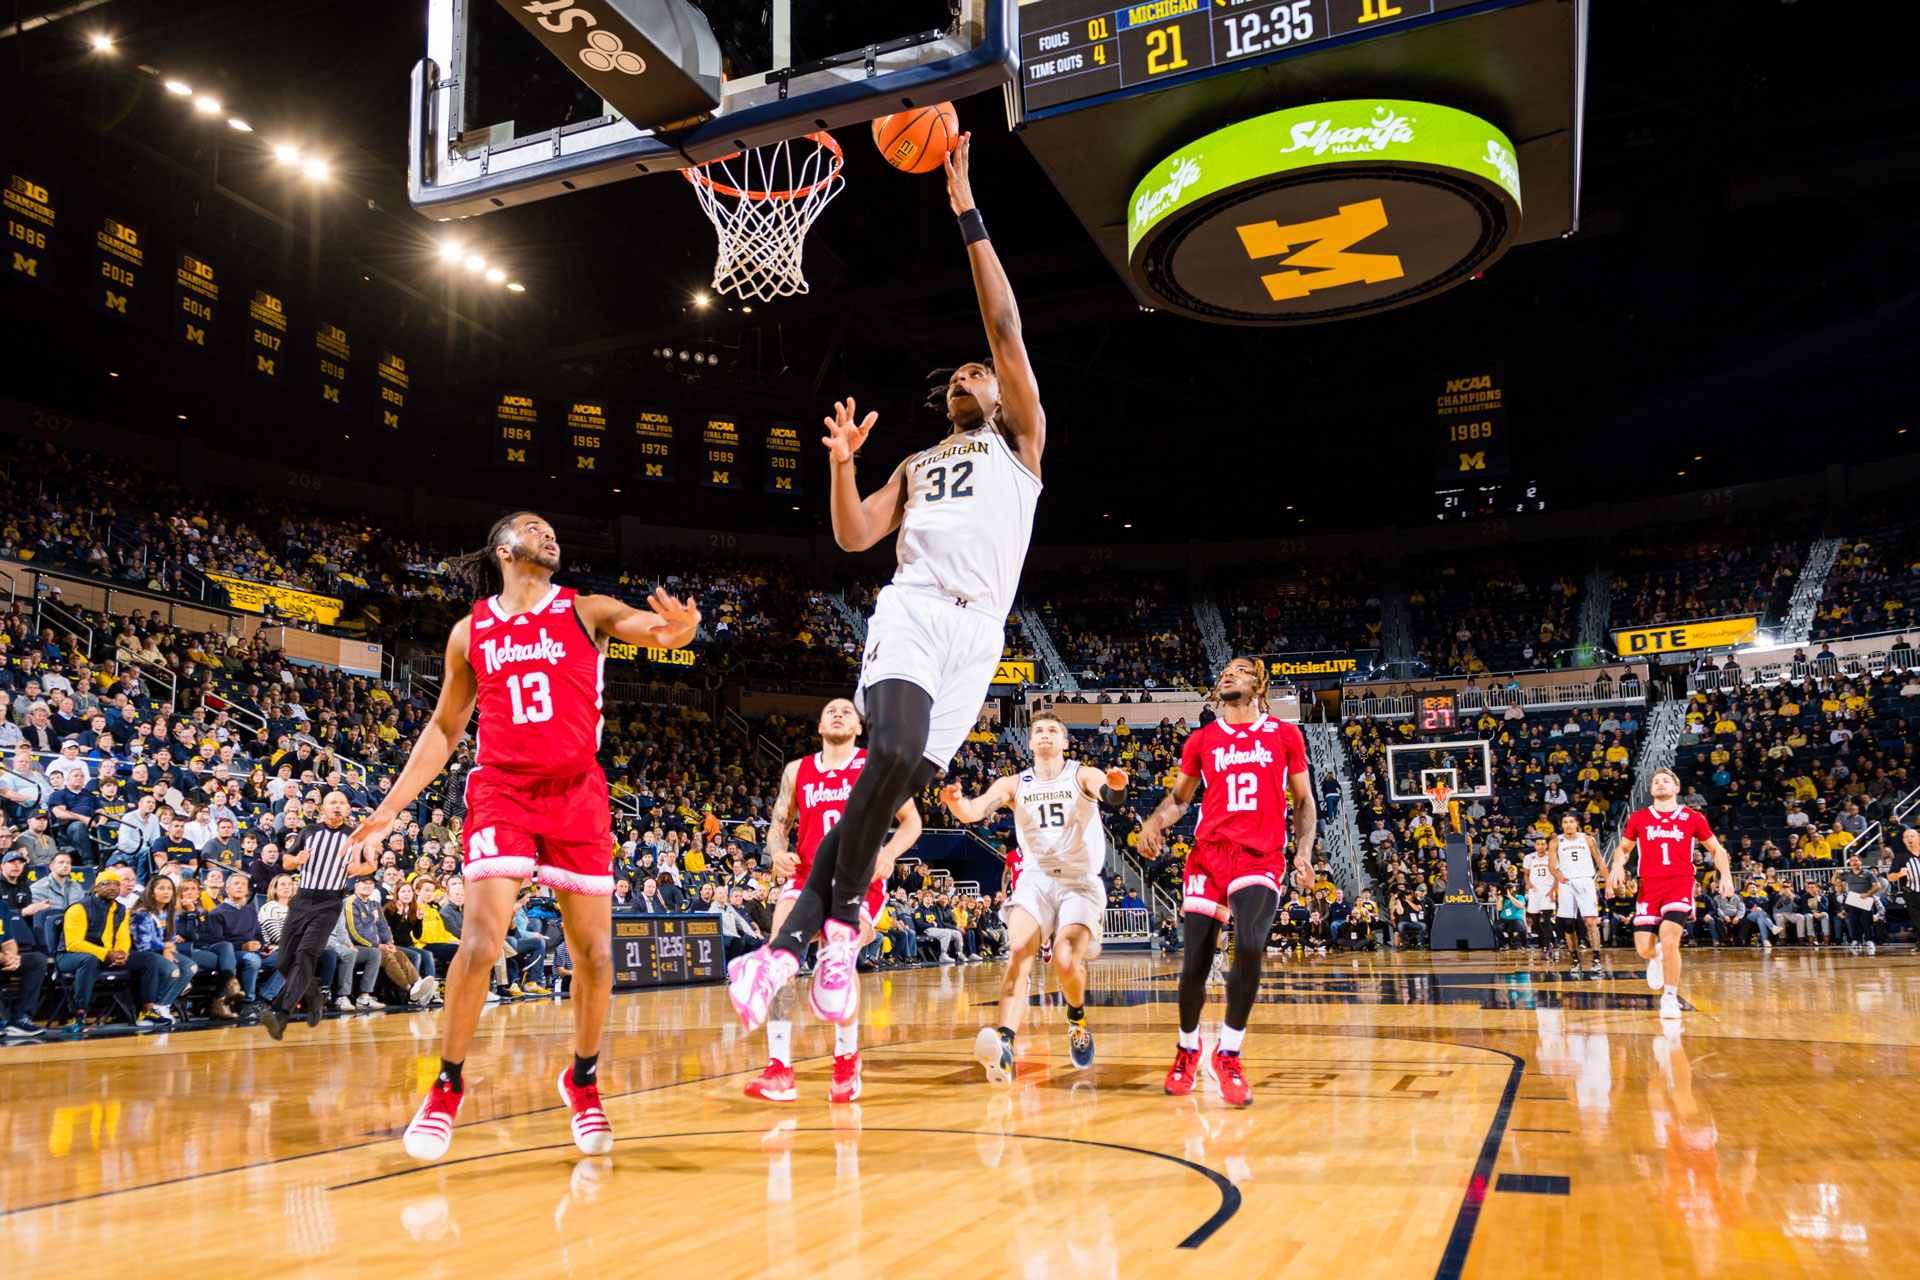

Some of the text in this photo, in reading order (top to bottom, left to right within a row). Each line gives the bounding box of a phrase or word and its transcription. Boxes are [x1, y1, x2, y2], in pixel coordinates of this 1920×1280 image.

[1128, 0, 1198, 26] MICHIGAN
[1039, 18, 1108, 51] FOULS 01
[1223, 0, 1314, 58] 12:35
[1146, 25, 1188, 75] 21
[1029, 44, 1106, 80] TIME OUTS 4
[1280, 109, 1415, 156] Sharifa
[1332, 143, 1373, 154] HALAL
[8, 220, 46, 250] 1986
[1236, 198, 1404, 301] M
[12, 252, 38, 278] M
[101, 261, 135, 288] 2012
[105, 289, 128, 314] M
[182, 297, 212, 321] 2014
[186, 323, 205, 346] M
[253, 329, 282, 351] 2017
[257, 354, 276, 376] M
[320, 359, 345, 381] 2018
[322, 384, 340, 404] M
[1445, 375, 1493, 394] NCAA
[503, 395, 533, 408] NCAA
[1436, 388, 1502, 408] CHAMPIONS
[384, 409, 399, 429] M
[497, 405, 538, 417] FINAL FOUR
[567, 413, 607, 425] FINAL FOUR
[572, 403, 602, 416] NCAA
[641, 412, 669, 424] NCAA
[32, 411, 73, 433] 207
[636, 422, 656, 433] FINAL
[657, 425, 673, 434] FOUR
[707, 420, 735, 432] NCAA
[1449, 421, 1493, 442] 1989
[502, 427, 532, 441] 1964
[572, 434, 601, 448] 1965
[703, 430, 739, 441] FINAL FOUR
[765, 437, 801, 447] FINAL FOUR
[770, 427, 797, 439] NCAA
[506, 448, 526, 463] M
[641, 442, 668, 456] 1976
[708, 450, 734, 464] 1989
[914, 441, 989, 473] MICHIGAN
[576, 455, 596, 470] M
[645, 463, 663, 477] M
[771, 457, 796, 469] 2013
[1458, 450, 1486, 472] M
[288, 472, 323, 490] 208
[712, 470, 730, 484] M
[775, 476, 792, 490] M
[925, 460, 974, 503] 32
[709, 534, 736, 549] 210
[229, 591, 316, 615] CREDIT UNION
[292, 593, 343, 609] MICHIGAN
[955, 597, 968, 609] M
[1630, 629, 1686, 652] DTE
[480, 628, 566, 674] Nebraska
[1271, 659, 1357, 675] #CrislerLIVE
[506, 672, 554, 725] 13
[1424, 708, 1451, 730] 27
[1212, 740, 1273, 772] Nebraska
[1023, 791, 1072, 804] MICHIGAN
[1226, 773, 1257, 812] 12
[1038, 803, 1065, 828] 15
[469, 826, 499, 861] N
[1645, 825, 1684, 842] Nebraska
[1571, 851, 1578, 861] 5
[1661, 843, 1671, 865] 1
[1537, 868, 1546, 877] 13
[1187, 874, 1207, 895] N
[1445, 895, 1473, 903] UMCU
[626, 942, 642, 967] 21
[697, 940, 713, 963] 12
